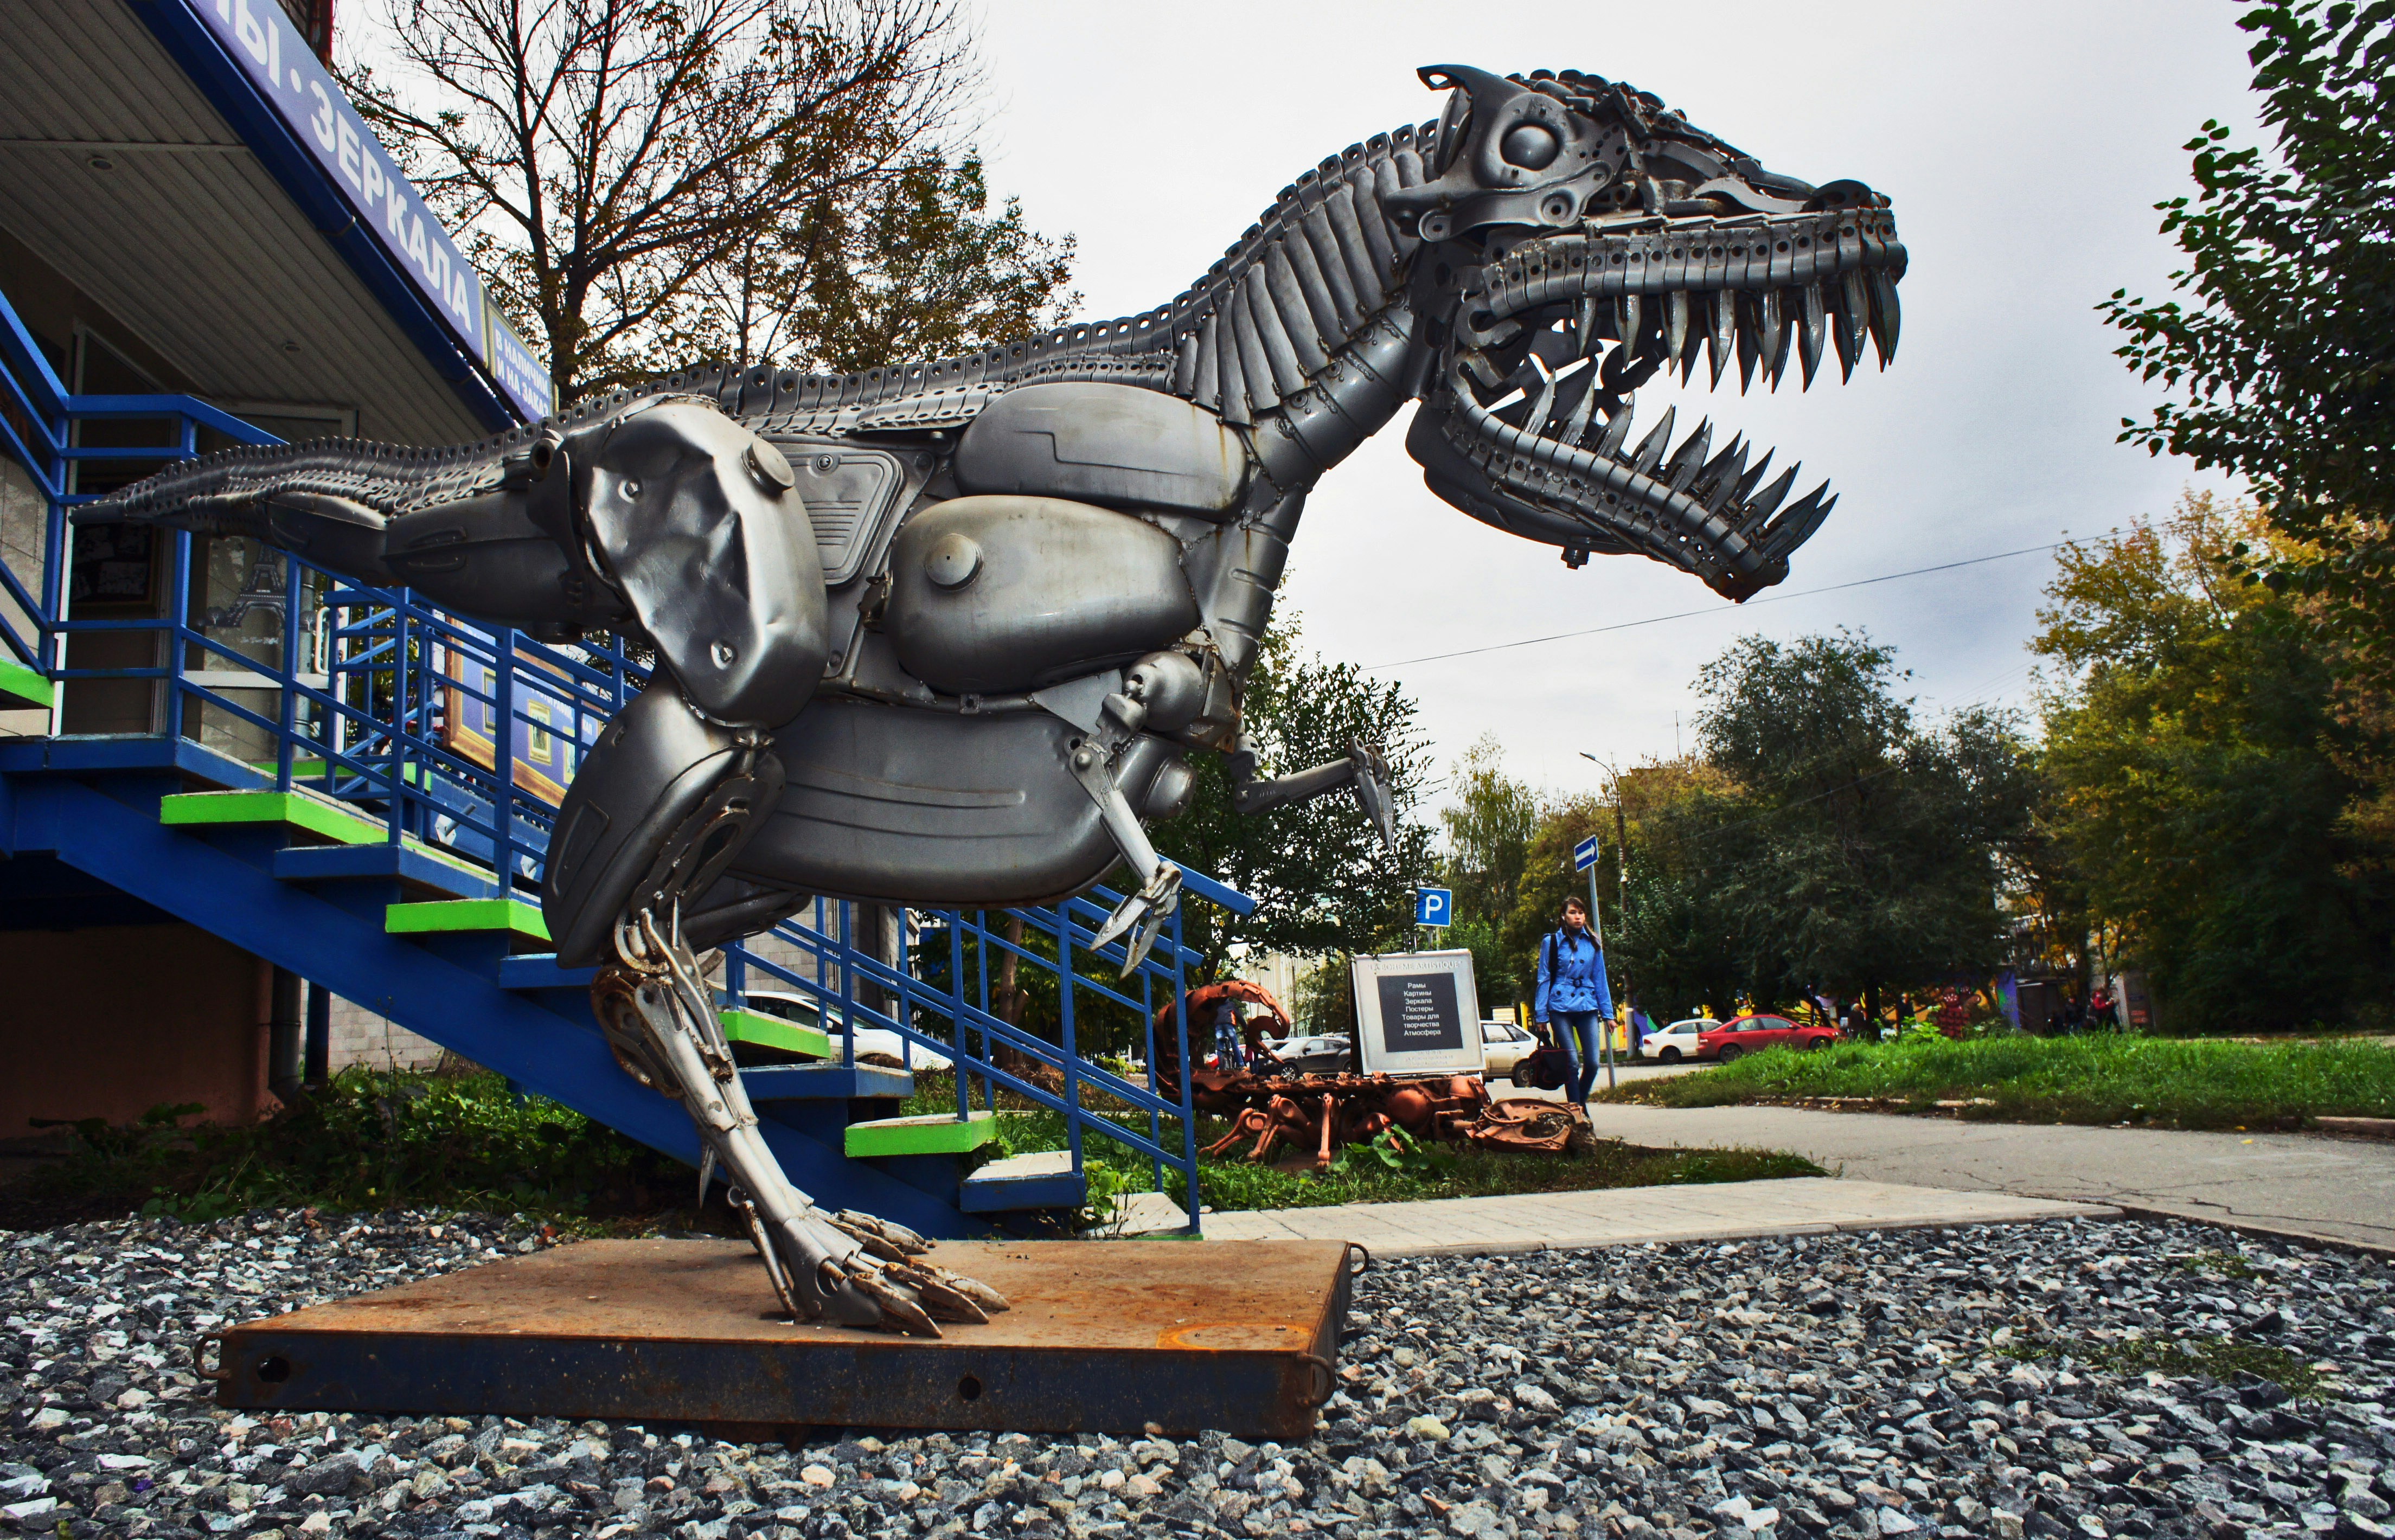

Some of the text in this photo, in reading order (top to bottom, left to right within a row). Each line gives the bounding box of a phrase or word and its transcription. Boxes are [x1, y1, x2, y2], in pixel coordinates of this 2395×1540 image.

[311, 80, 472, 332] ЗЕРКАЛА
[495, 329, 548, 398] В НАЛИЧИИ
[497, 356, 549, 417] И НА ЗАКАЗ
[1425, 894, 1443, 919] P
